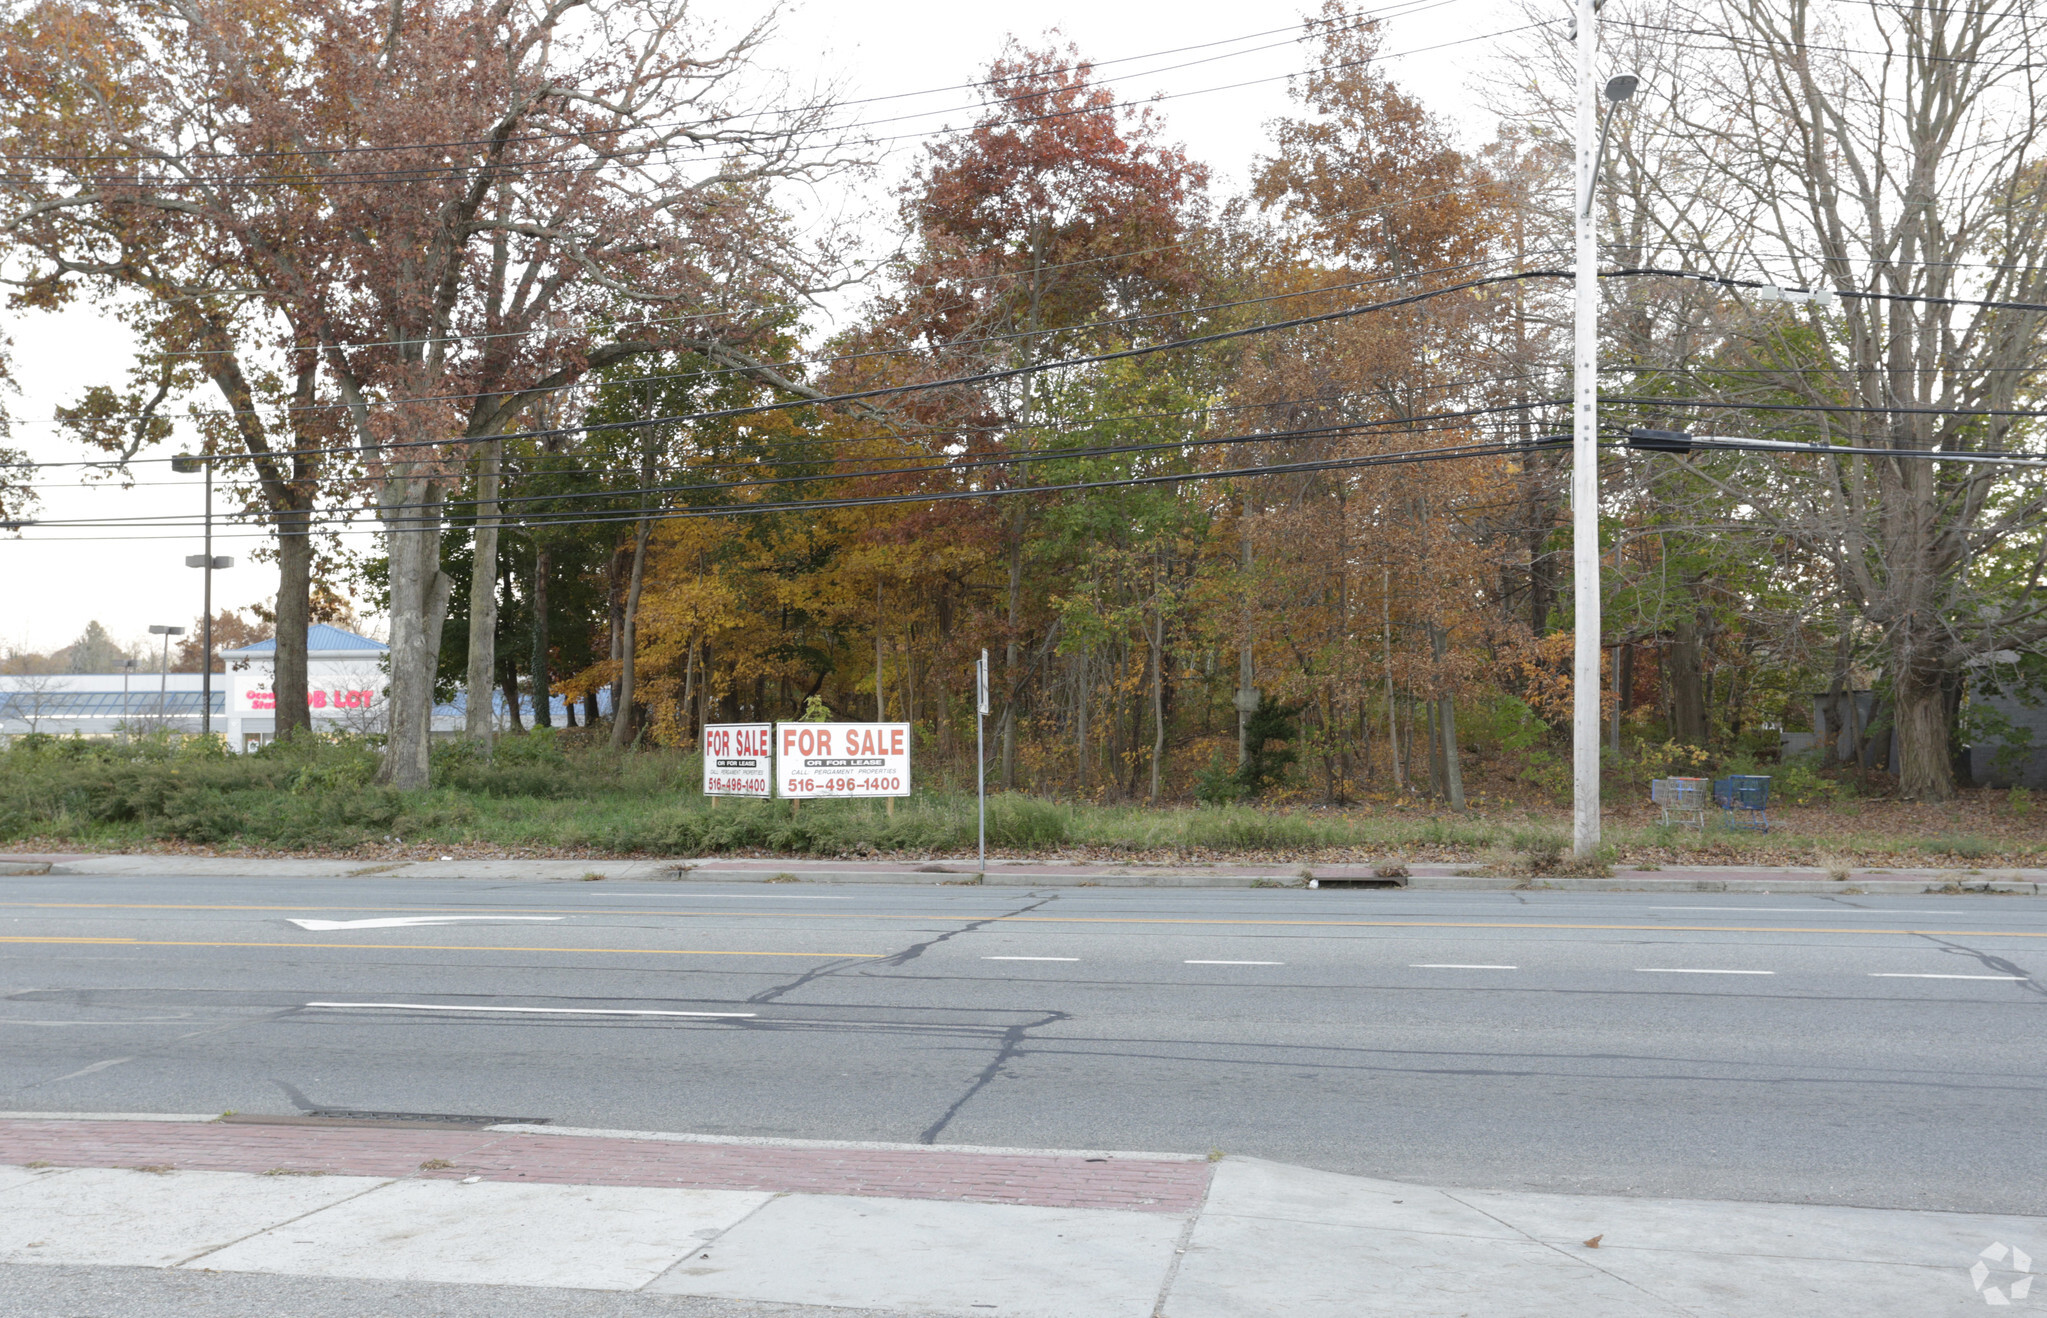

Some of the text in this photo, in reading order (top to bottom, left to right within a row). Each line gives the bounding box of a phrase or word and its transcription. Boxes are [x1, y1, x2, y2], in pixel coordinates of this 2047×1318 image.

[246, 690, 276, 700] Ocea
[334, 690, 374, 709] LOT
[707, 730, 768, 757] FOR SALE
[783, 729, 904, 756] FOR SALE
[708, 777, 766, 792] 516-496-1400
[788, 777, 900, 792] 516-496-1400
